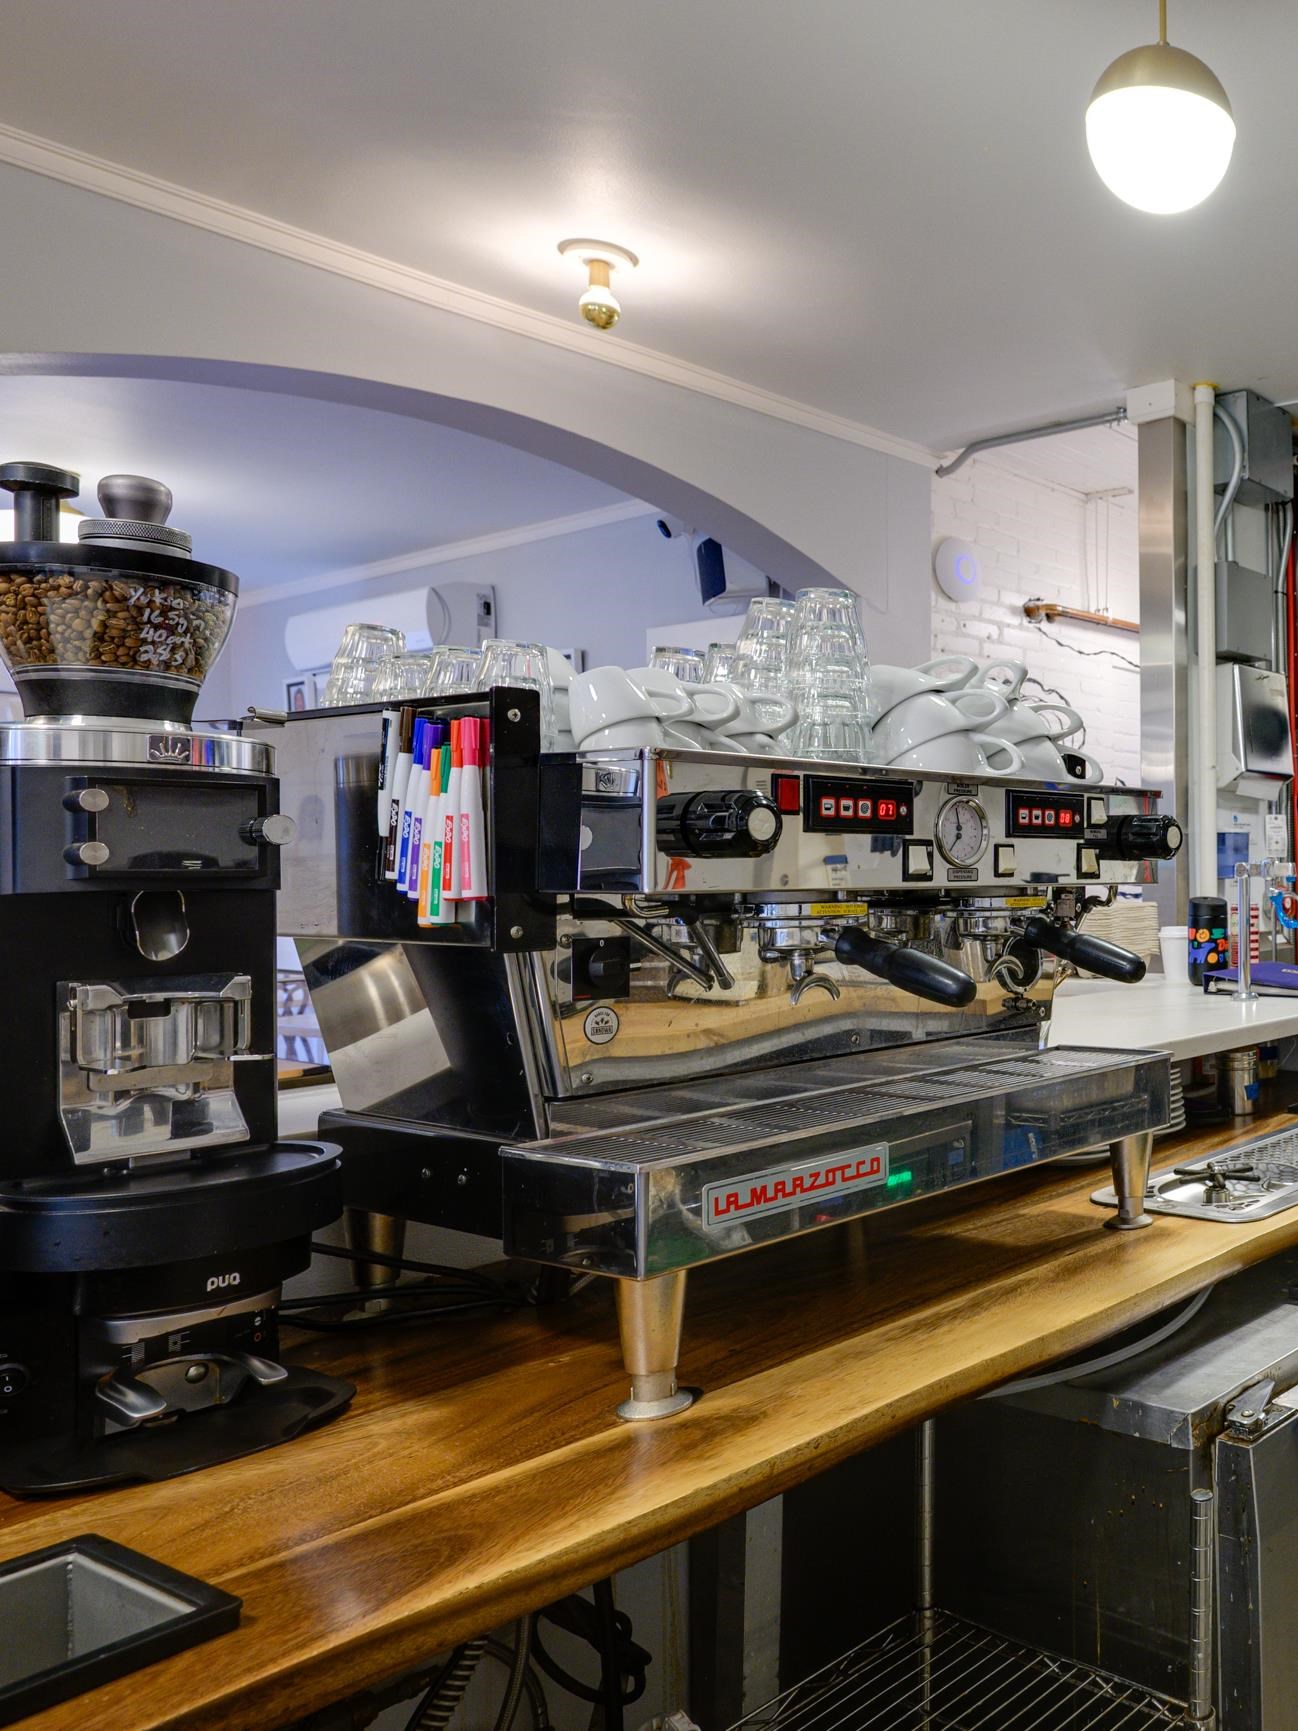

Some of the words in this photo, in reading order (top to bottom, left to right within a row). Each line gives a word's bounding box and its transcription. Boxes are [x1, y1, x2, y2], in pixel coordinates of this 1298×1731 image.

[879, 803, 893, 815] 07
[714, 1191, 751, 1217] LA
[750, 1156, 881, 1206] MARZOCCO
